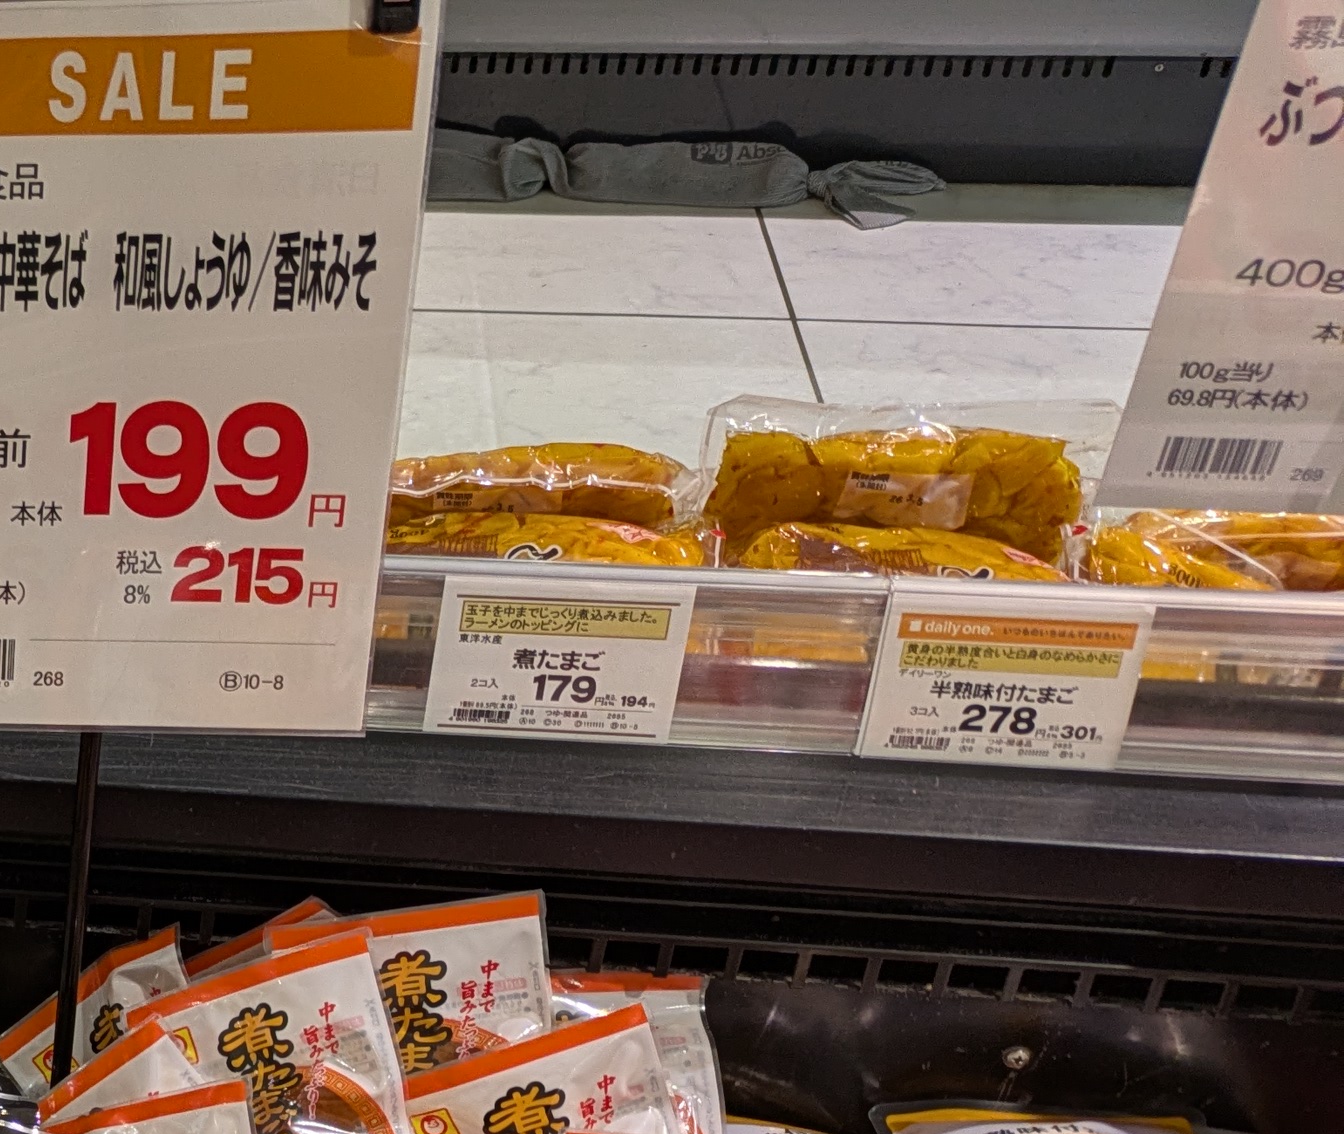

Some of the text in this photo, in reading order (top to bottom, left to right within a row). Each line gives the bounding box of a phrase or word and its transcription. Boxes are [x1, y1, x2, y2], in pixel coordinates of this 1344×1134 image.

[48, 48, 253, 124] SALE
[1179, 361, 1273, 382] 100g当り
[1167, 389, 1308, 410] 69.8円(本体)
[10, 501, 63, 526] 本体
[69, 400, 310, 520] 199
[116, 550, 162, 575] 税込
[124, 585, 151, 605] 8%
[464, 617, 588, 632] ラーメンのトッピングに
[466, 605, 658, 624] 玉子を中までじっくり煮込みました。
[459, 633, 502, 644] 東洋水産
[512, 648, 605, 671] 煮たまご
[903, 655, 978, 669] こだわりました
[33, 671, 64, 688] 268
[471, 677, 499, 689] 2コ入
[533, 674, 596, 703] 179
[930, 680, 1079, 705] 半熟味付たまご
[910, 706, 939, 718] 3コ入
[959, 704, 1037, 735] 278
